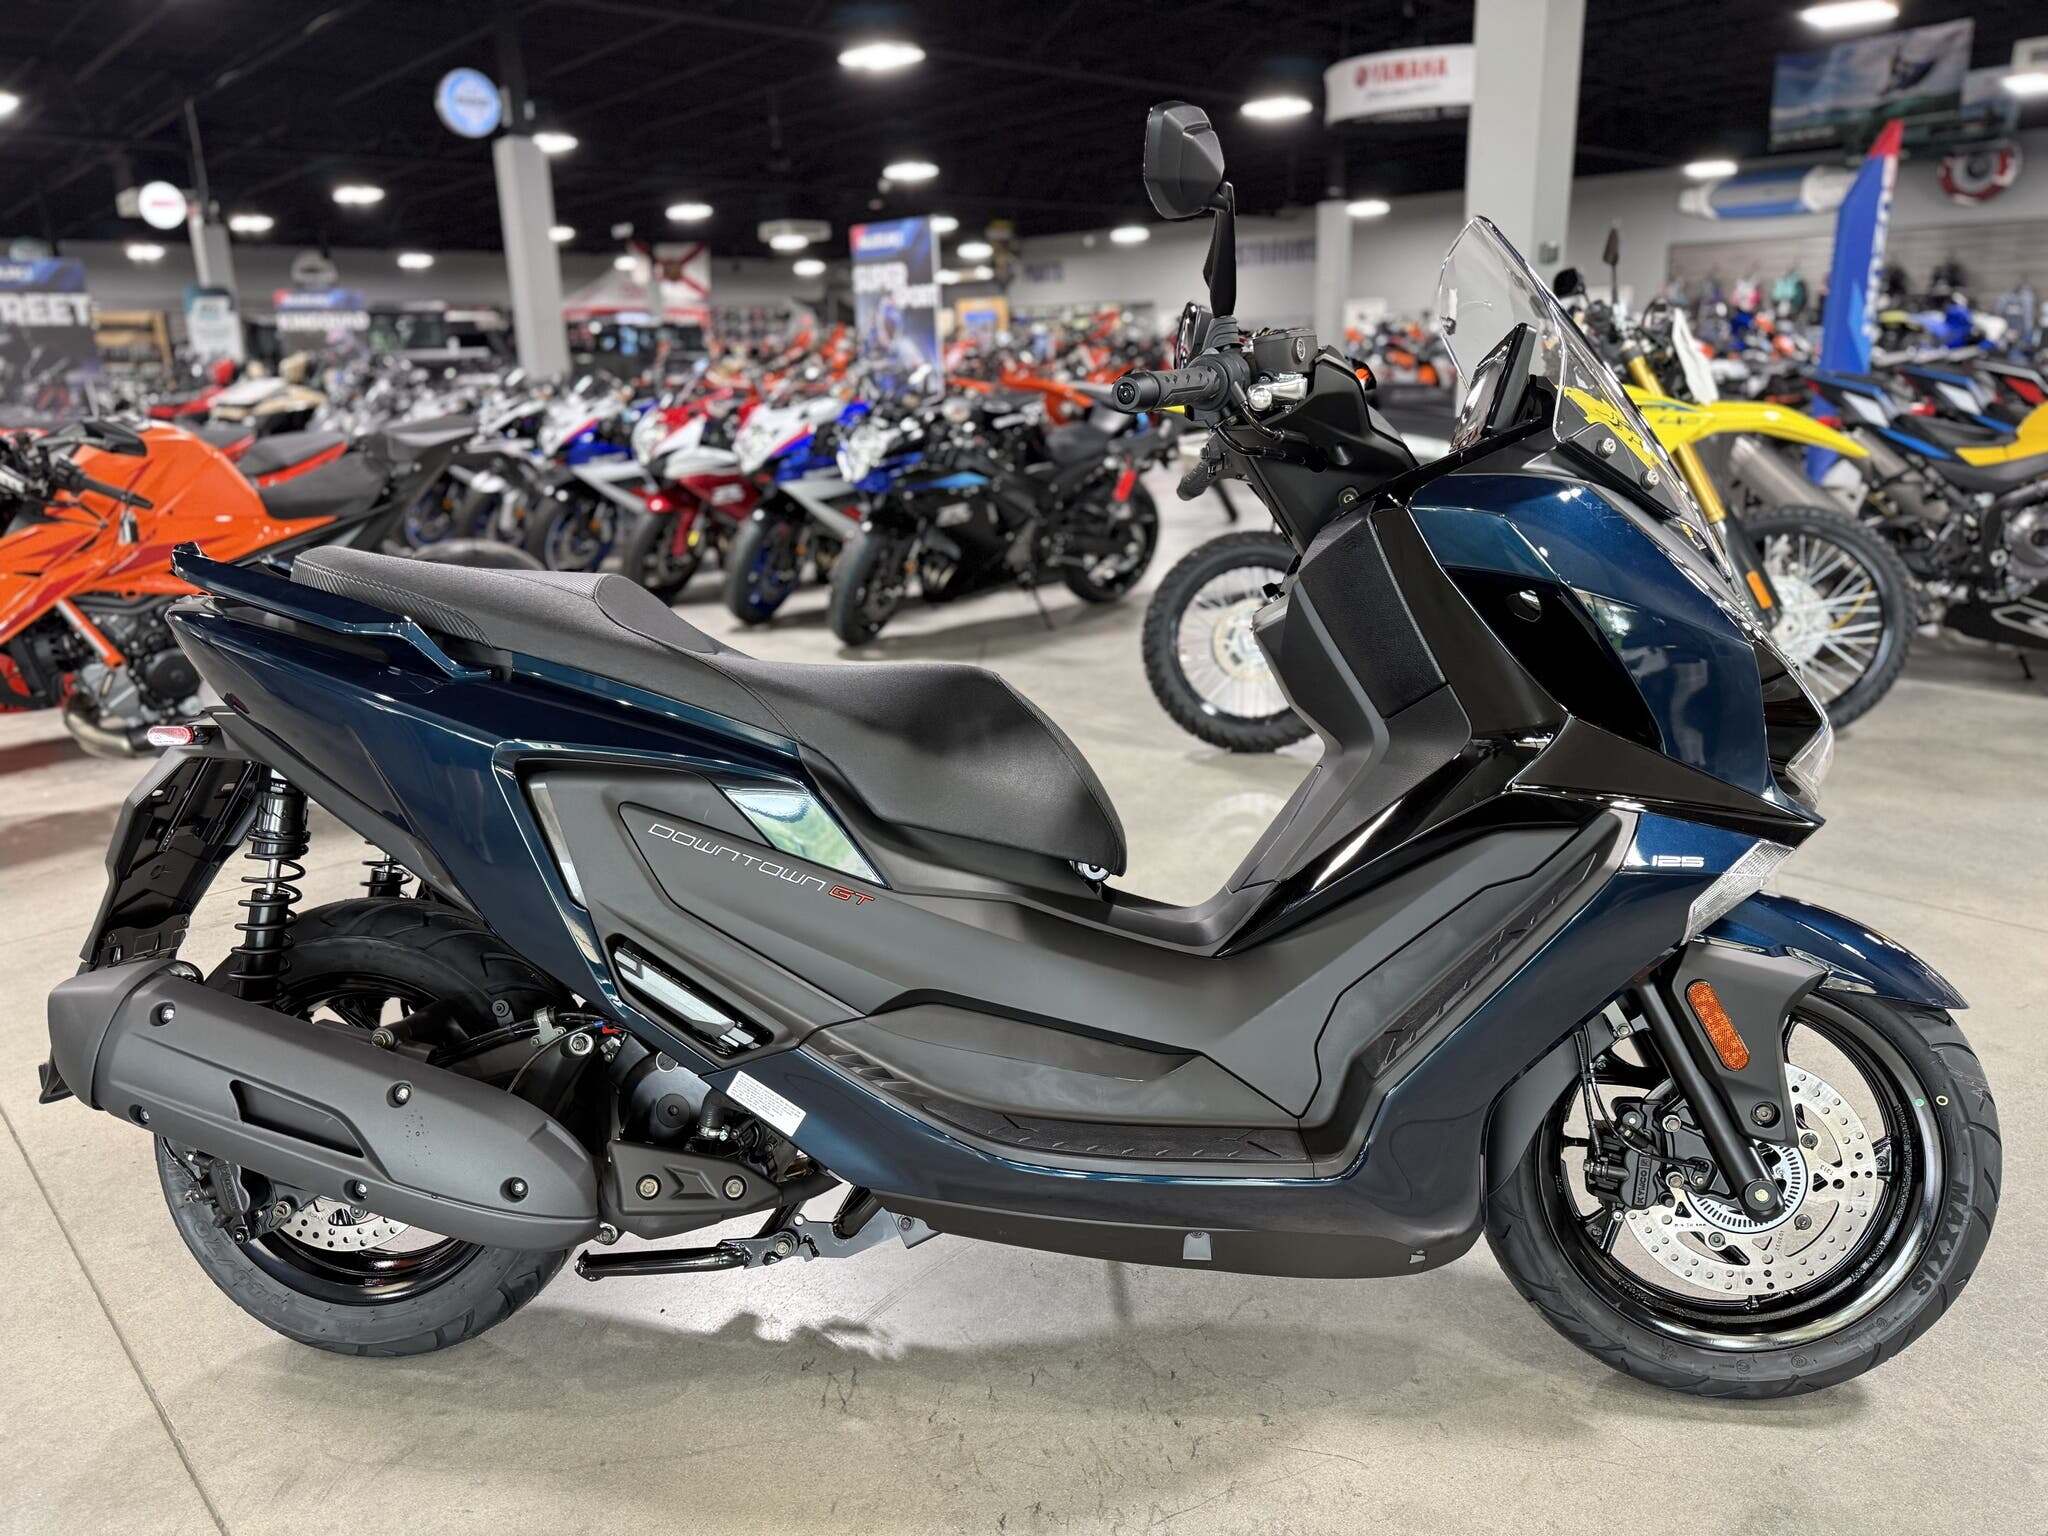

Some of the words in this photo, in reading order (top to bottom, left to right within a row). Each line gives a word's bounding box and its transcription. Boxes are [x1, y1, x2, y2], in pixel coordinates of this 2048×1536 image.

[648, 824, 826, 891] DOWNTOWN
[828, 884, 874, 905] GT
[1652, 855, 1704, 867] 125
[1636, 1169, 1648, 1204] KYMCO
[1911, 1180, 1969, 1296] MAXXIS
